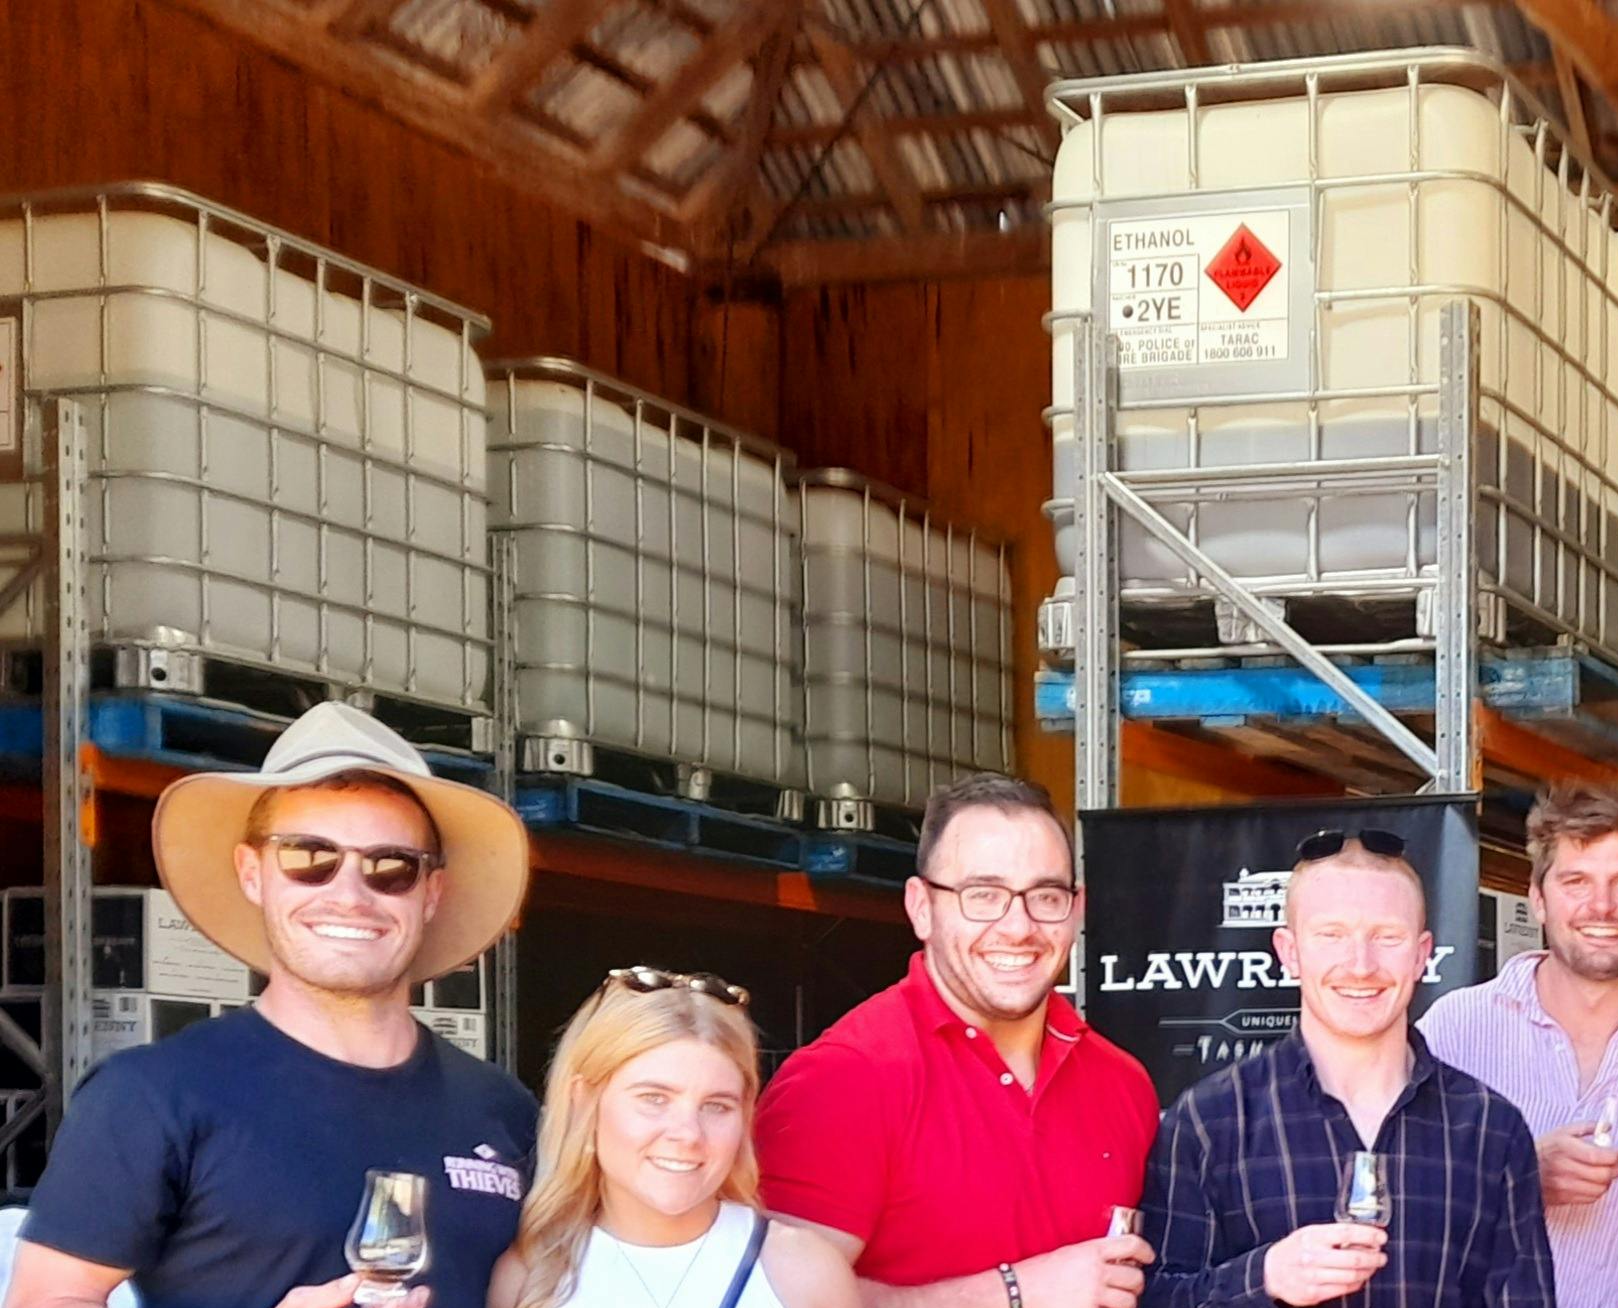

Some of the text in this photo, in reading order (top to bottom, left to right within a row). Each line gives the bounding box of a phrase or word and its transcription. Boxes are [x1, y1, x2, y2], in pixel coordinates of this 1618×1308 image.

[1113, 228, 1195, 251] ETHANOL
[1127, 261, 1184, 289] 1170
[1138, 338, 1180, 351] POLICE
[1221, 332, 1259, 346] TARAC
[1141, 349, 1192, 364] BRIGADE
[1099, 945, 1455, 992] LAWRY
[1241, 1015, 1297, 1028] UNIQUE
[444, 1167, 522, 1201] THIEVES
